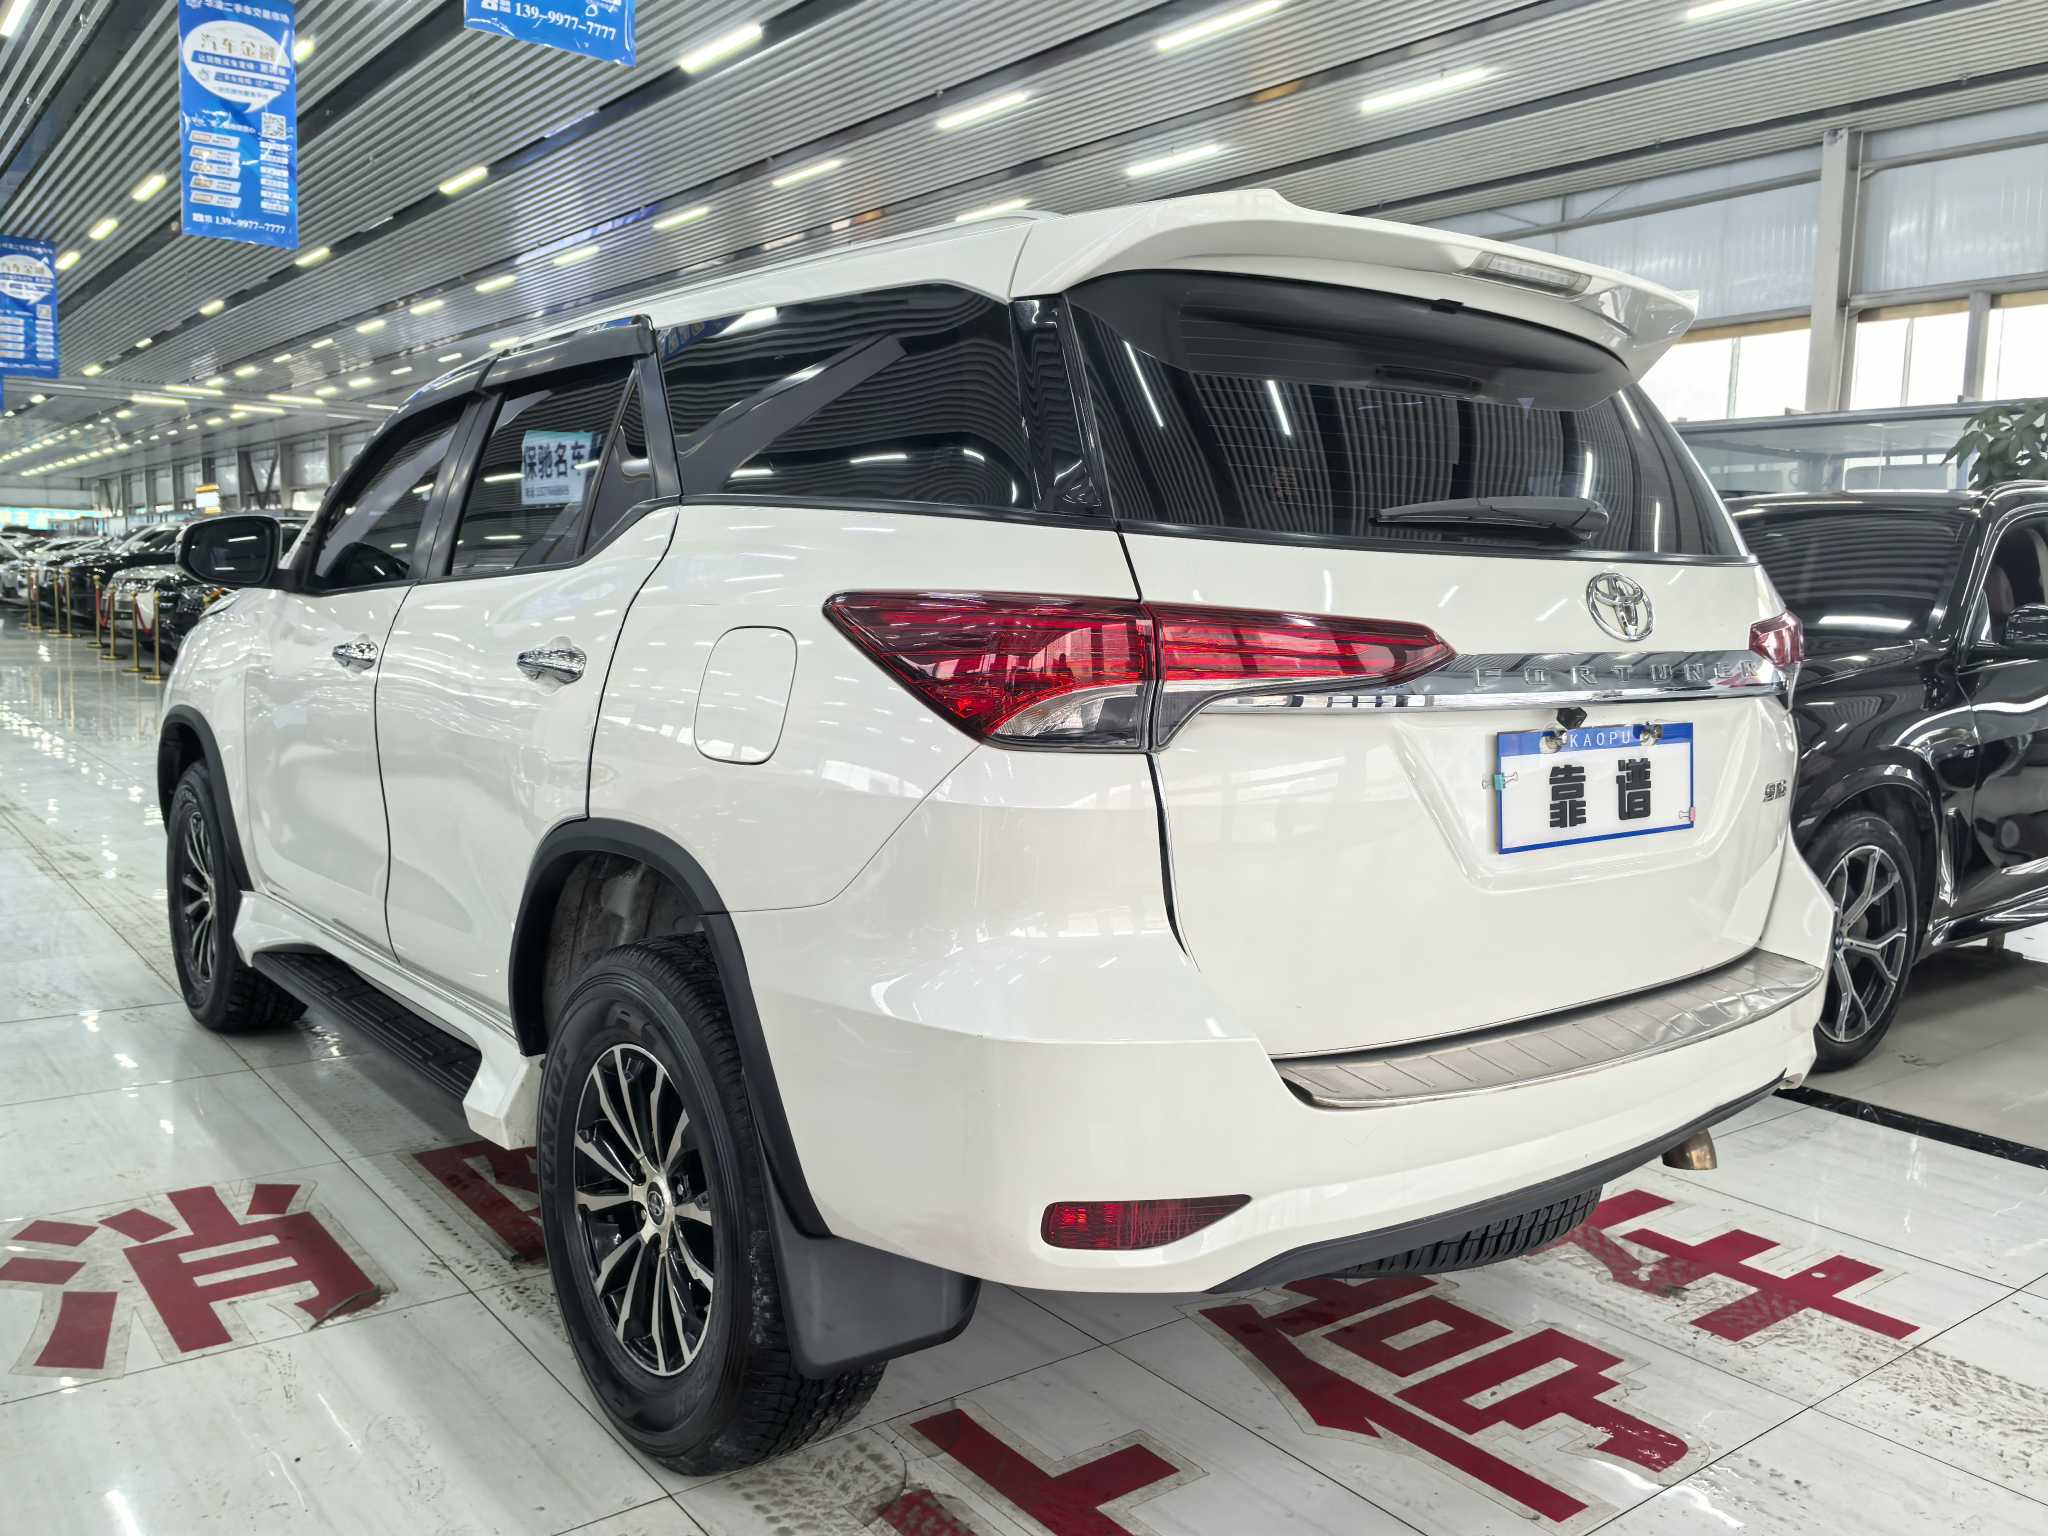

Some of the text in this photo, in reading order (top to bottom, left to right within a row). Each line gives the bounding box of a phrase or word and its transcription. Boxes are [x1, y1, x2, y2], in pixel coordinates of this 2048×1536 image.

[515, 3, 617, 41] 139-9977-7777
[1472, 659, 1758, 688] FORTUNER
[1569, 732, 1631, 748] KAOPU
[1548, 757, 1652, 829] 靠谱
